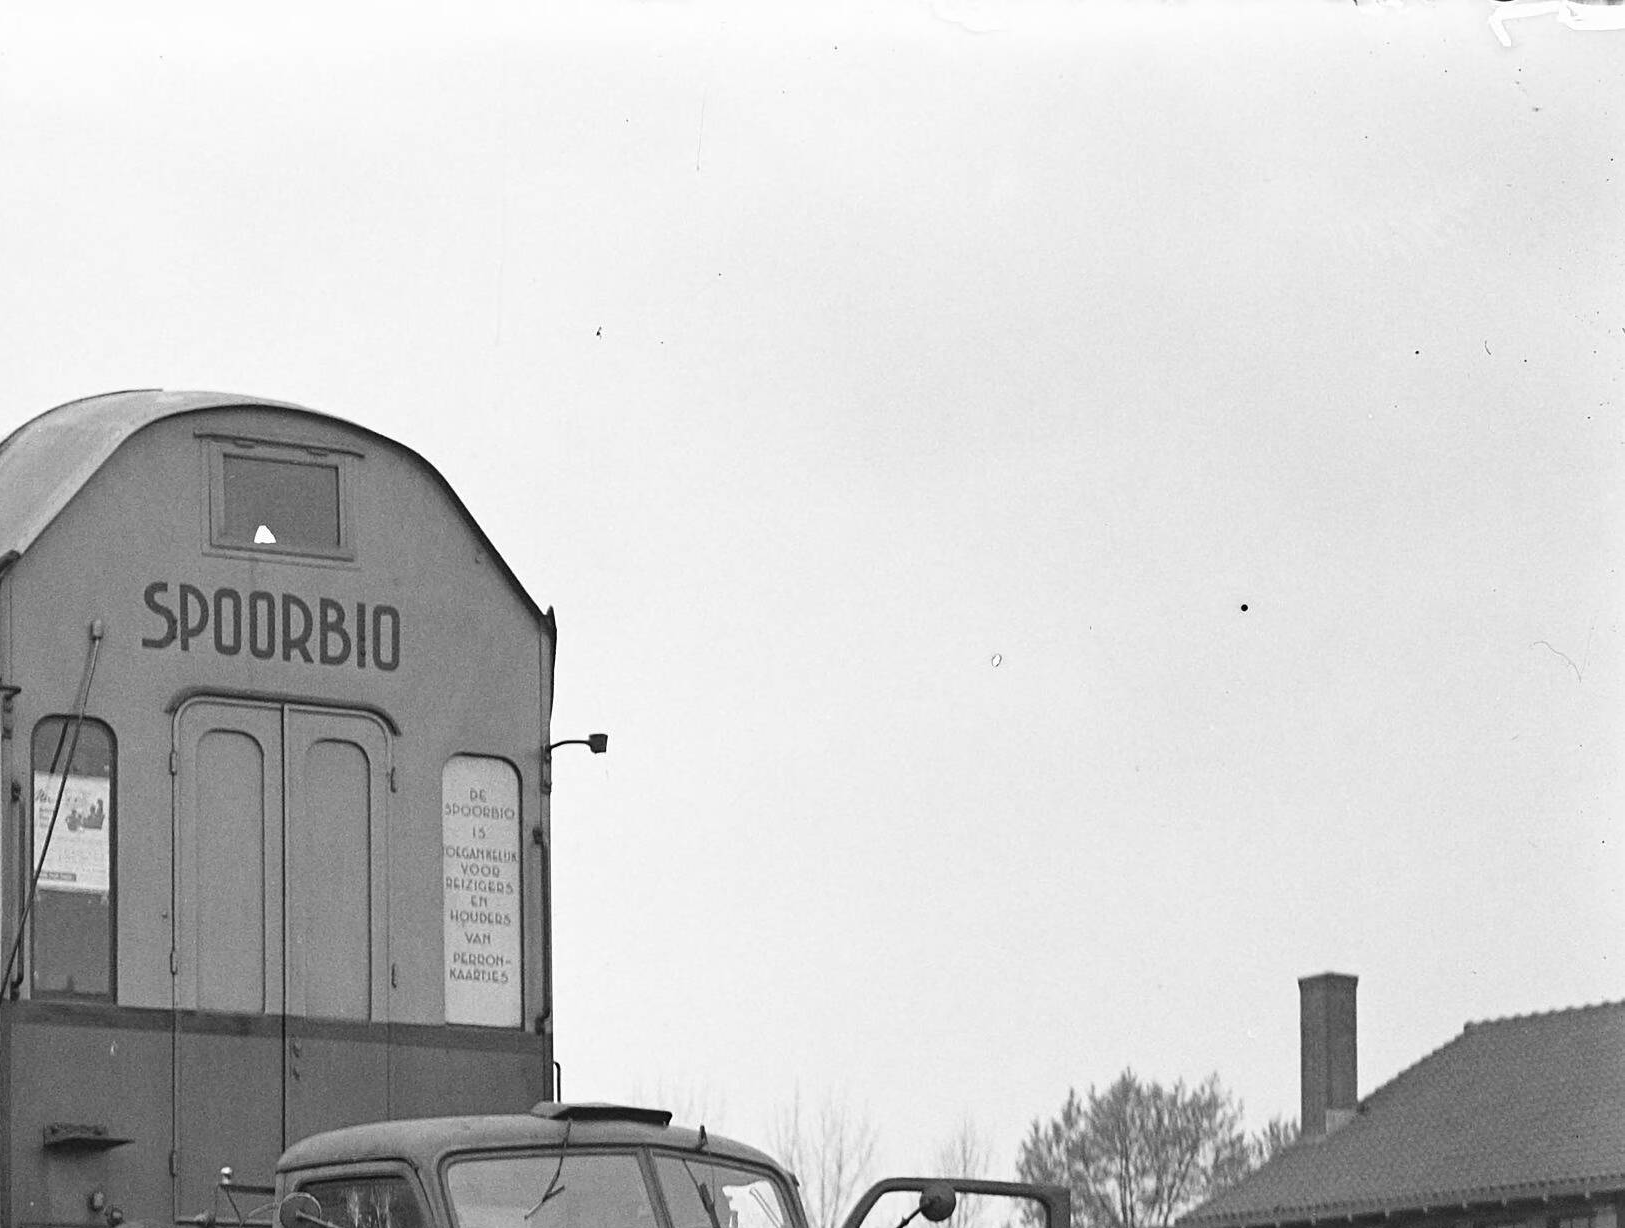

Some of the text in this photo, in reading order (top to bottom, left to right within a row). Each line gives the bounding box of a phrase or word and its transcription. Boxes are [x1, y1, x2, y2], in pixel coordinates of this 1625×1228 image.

[141, 581, 401, 671] SPOORBIO
[469, 787, 487, 803] DE
[444, 802, 515, 820] SPOORBIO
[460, 861, 500, 878] VOOR
[445, 876, 514, 895] REIZIGERS
[470, 895, 488, 907] EN
[450, 909, 512, 926] HOUDERS
[464, 931, 491, 944] VAN
[453, 951, 512, 967] PERRON-
[449, 967, 509, 984] KAARTJES
